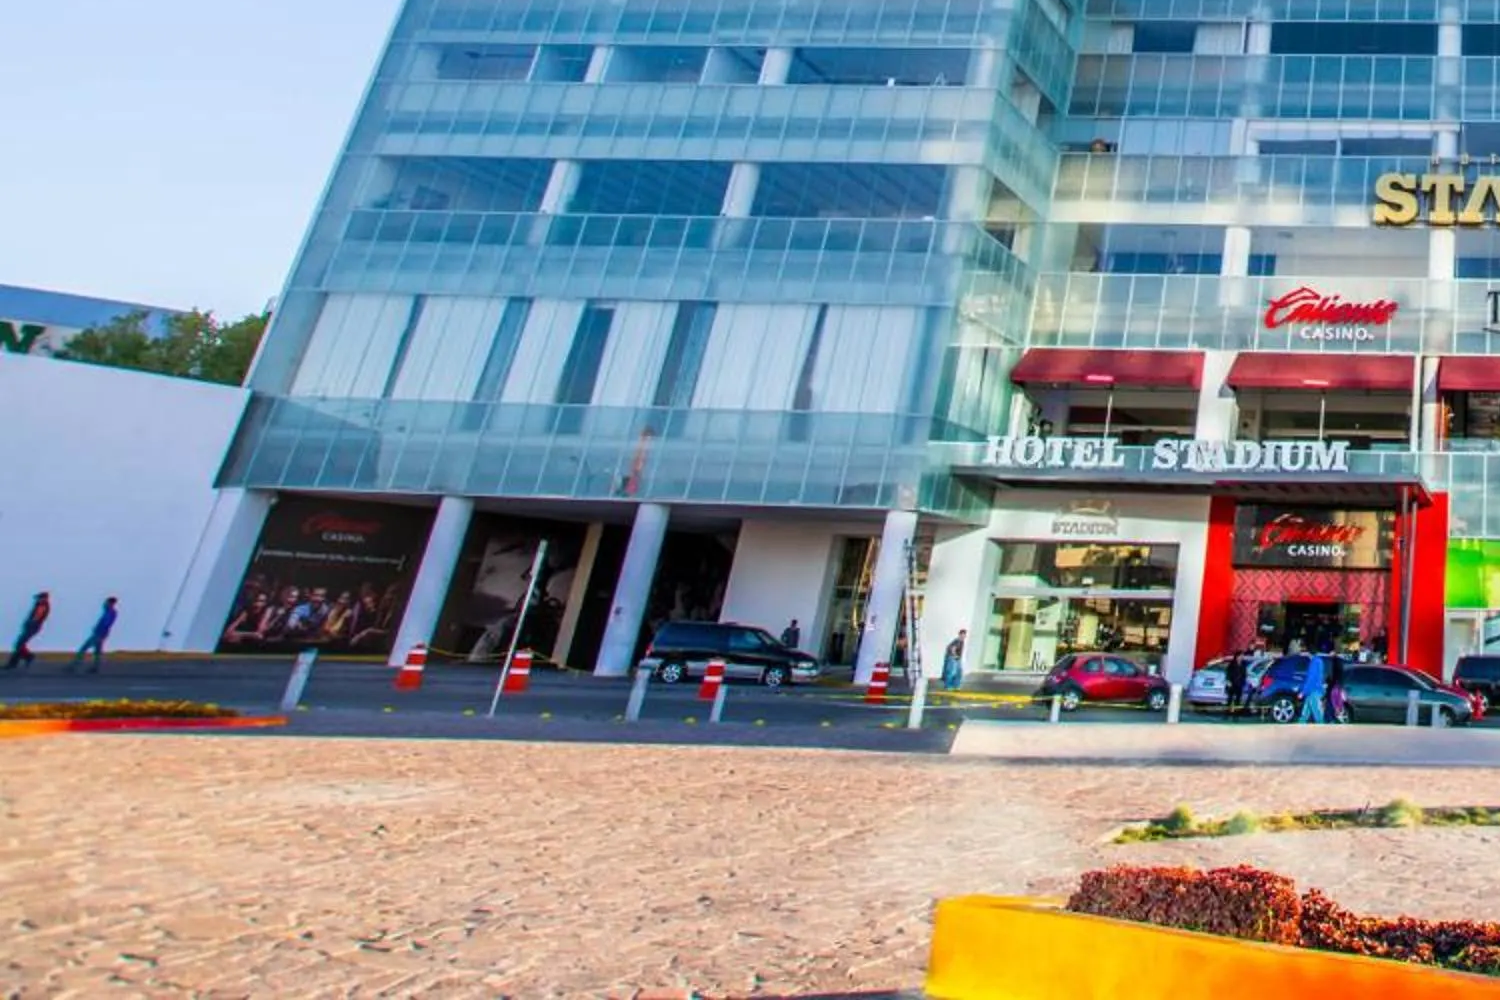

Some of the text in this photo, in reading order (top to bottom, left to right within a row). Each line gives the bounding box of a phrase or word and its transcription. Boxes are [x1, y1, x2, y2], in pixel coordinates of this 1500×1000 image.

[1300, 327, 1370, 340] CASINO
[982, 435, 1350, 472] HOTEL STADIUM
[1287, 545, 1343, 557] CASINO
